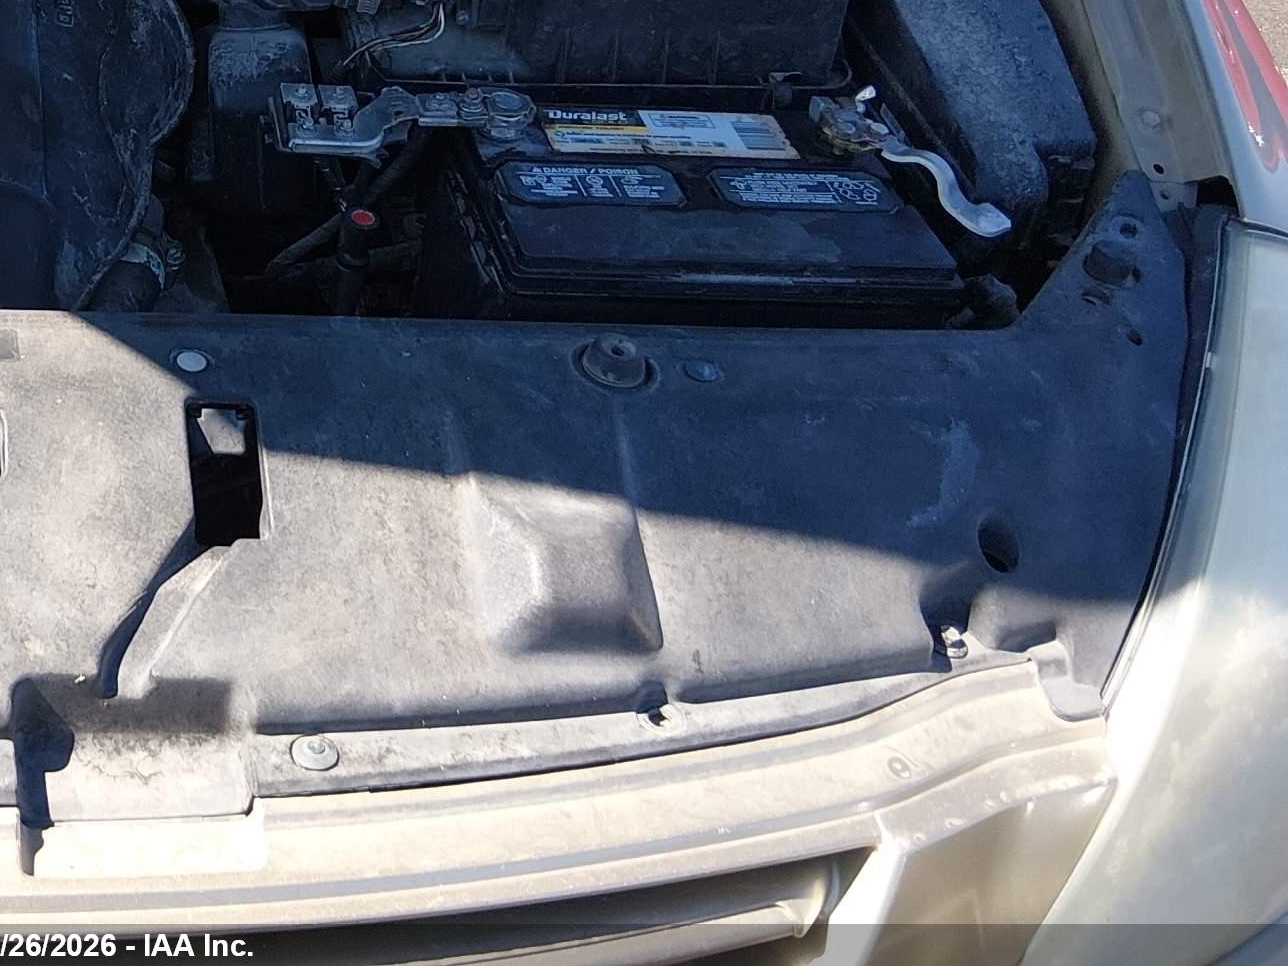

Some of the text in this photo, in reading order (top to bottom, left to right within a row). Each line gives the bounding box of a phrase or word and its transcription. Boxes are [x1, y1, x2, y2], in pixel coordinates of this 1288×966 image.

[543, 109, 628, 121] Duralast
[543, 167, 588, 175] DANGER
[598, 168, 640, 176] POISON
